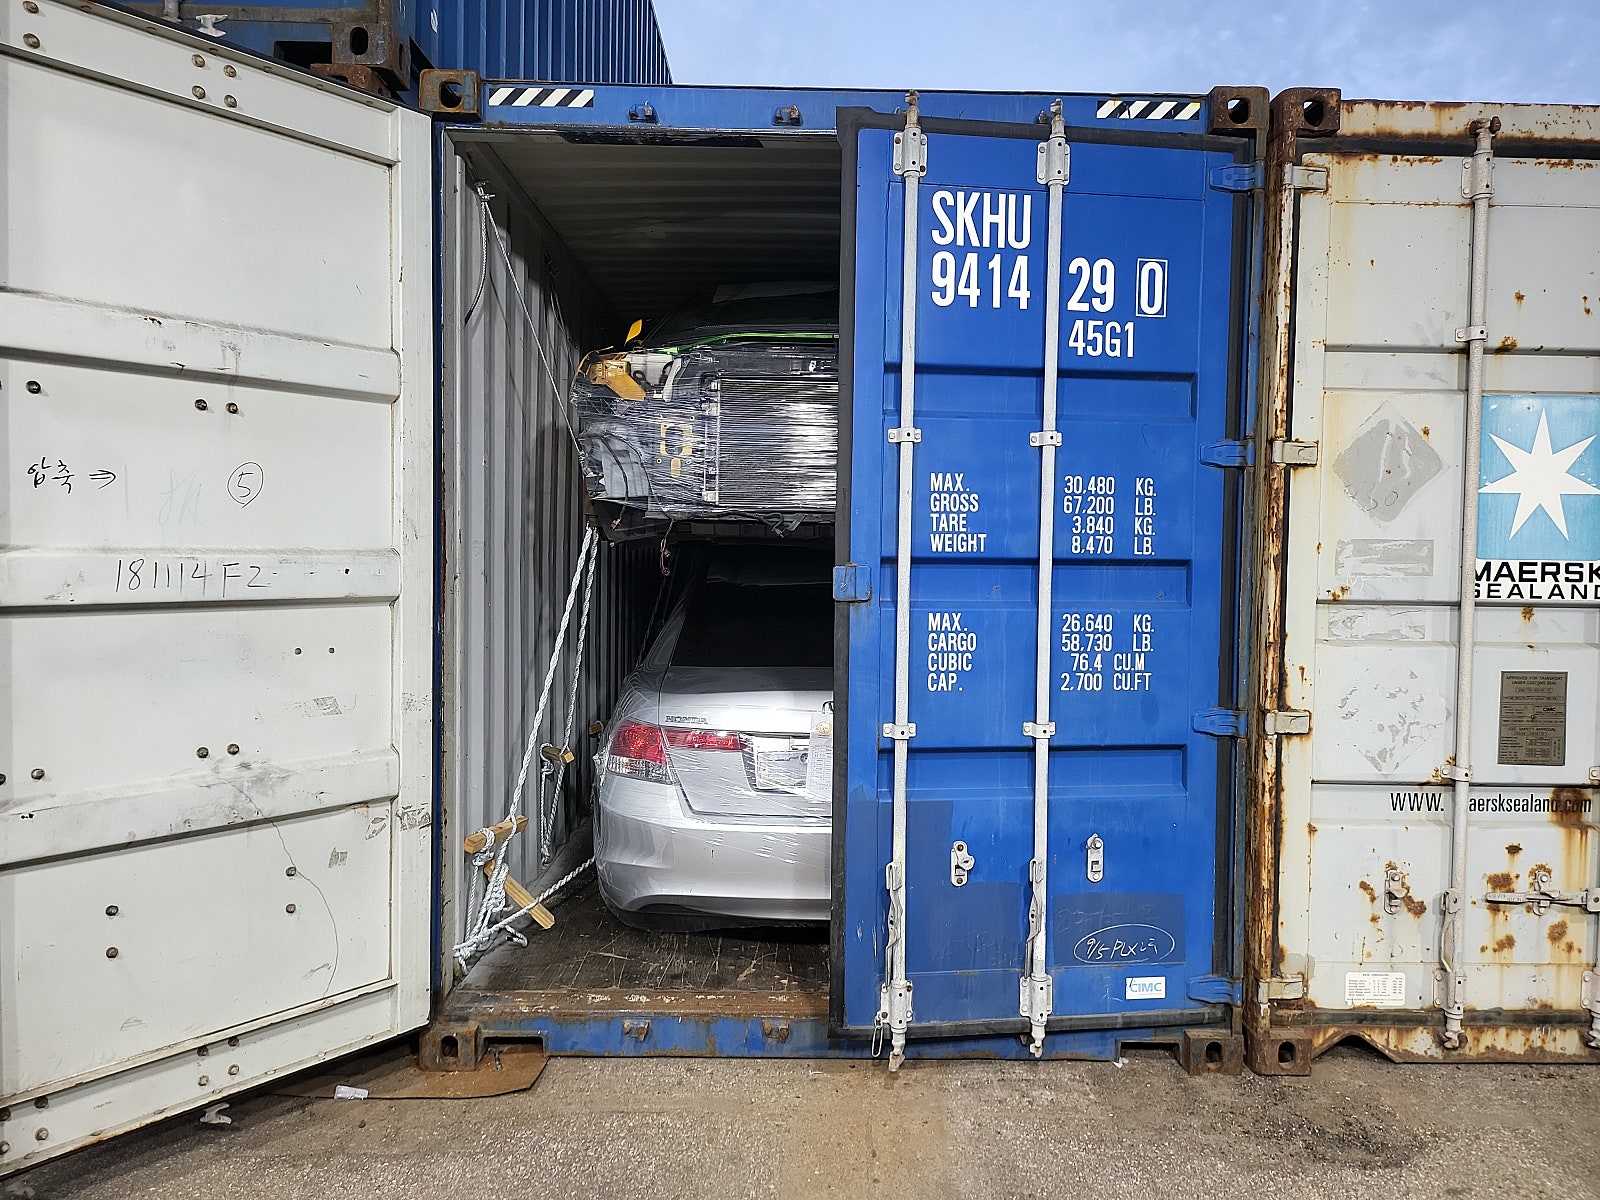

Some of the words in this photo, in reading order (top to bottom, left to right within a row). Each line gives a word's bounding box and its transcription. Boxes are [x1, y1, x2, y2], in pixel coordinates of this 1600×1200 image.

[931, 190, 1032, 250] SKHU
[931, 250, 1031, 310] 9414
[1067, 257, 1115, 312] 29
[1140, 261, 1163, 315] 0
[1068, 319, 1135, 358] 45G1
[930, 472, 970, 492] MAX.
[1064, 475, 1115, 495] 30,480
[1135, 477, 1157, 497] KG.
[930, 493, 979, 512] GROSS
[1063, 495, 1115, 515] 67,200
[1135, 497, 1156, 516] LB.
[930, 513, 967, 532] TARE
[1072, 516, 1114, 535] 3,840
[1134, 517, 1156, 536] KG.
[930, 533, 987, 552] WEIGHT
[1071, 535, 1113, 555] 8,470
[1133, 536, 1155, 556] LB.
[928, 612, 968, 632] MAX.
[1062, 613, 1113, 633] 26,640
[1133, 613, 1155, 633] KG.
[928, 632, 977, 652] CARGO
[1061, 633, 1113, 652] 58,730
[1132, 633, 1154, 652] LB.
[927, 652, 973, 672] CUBIC
[1070, 652, 1103, 672] 76.4
[1113, 652, 1145, 672] CU.M
[927, 672, 963, 692] CAP.
[1060, 672, 1103, 691] 2,700
[1113, 672, 1152, 691] CU.FT
[1130, 982, 1162, 993] CIMC
